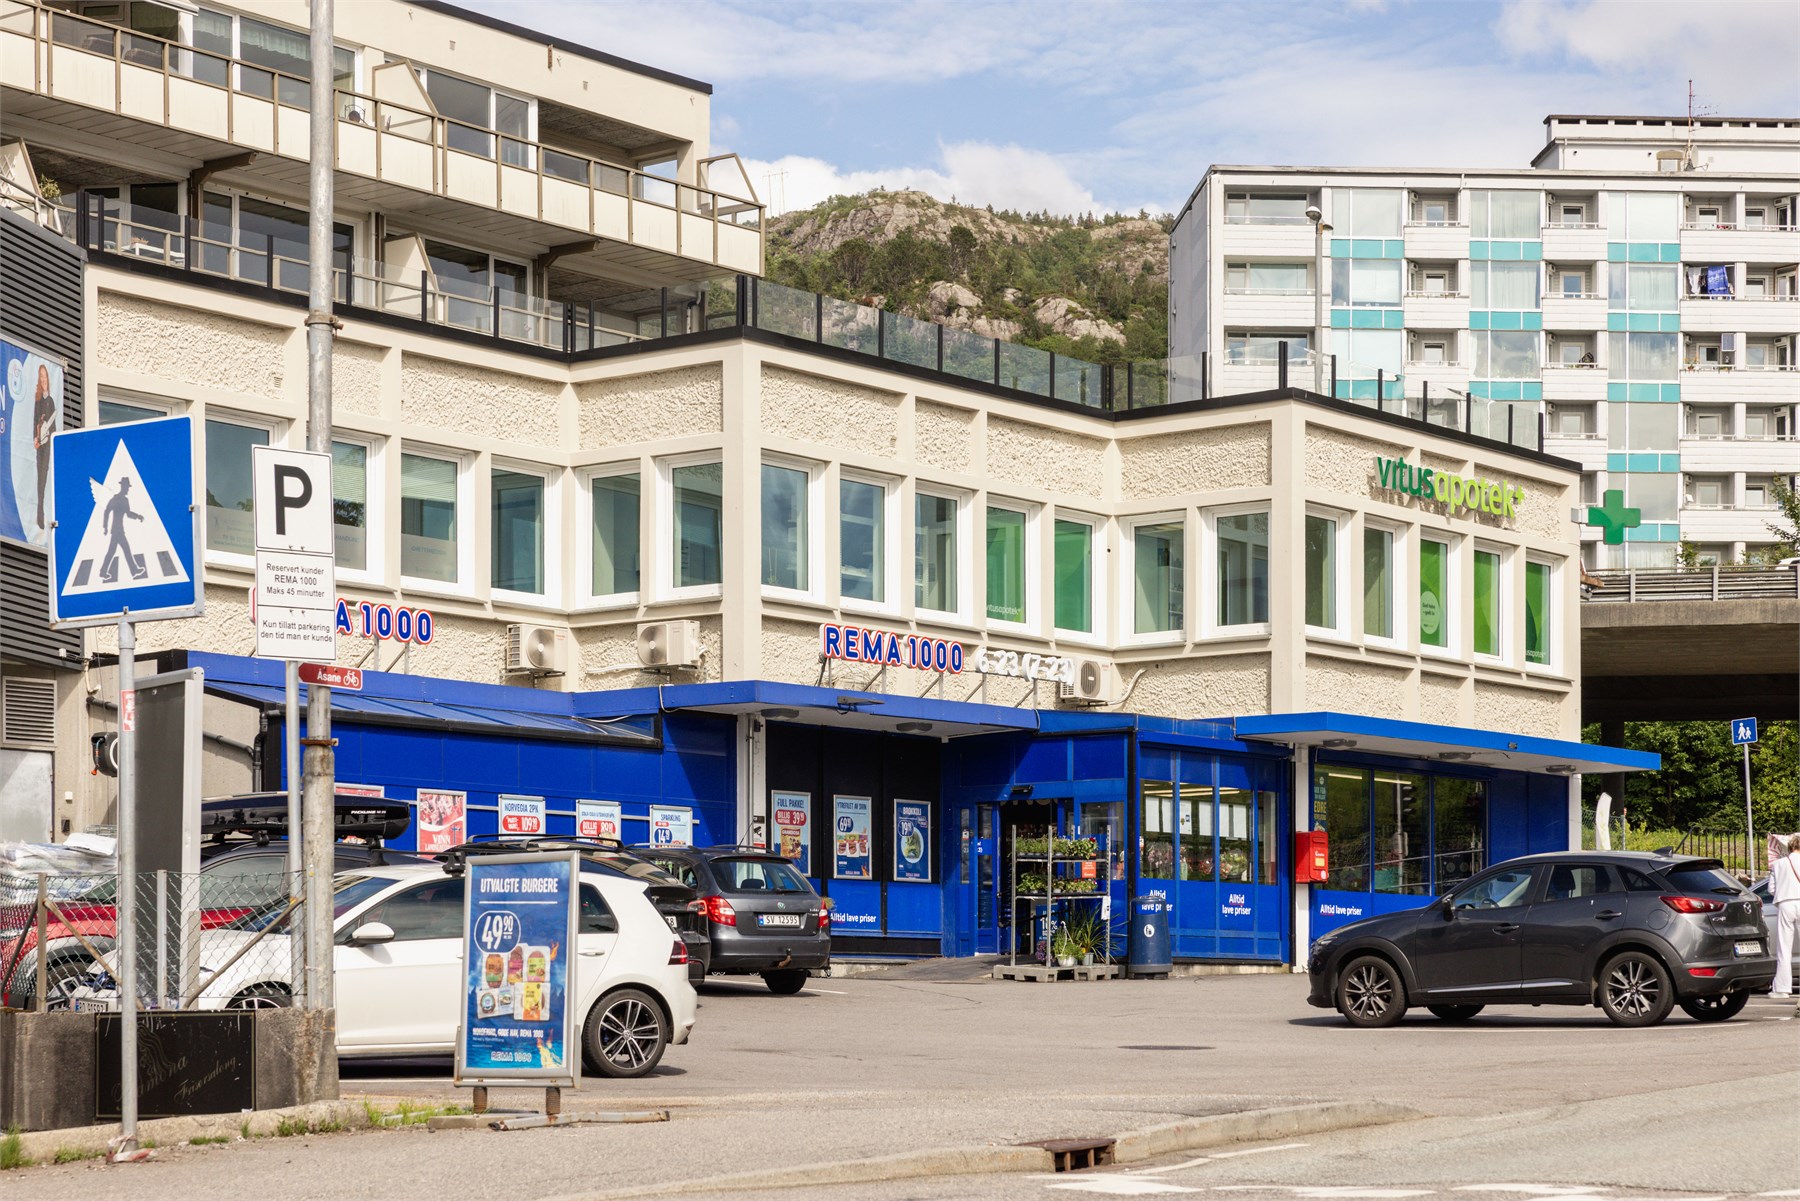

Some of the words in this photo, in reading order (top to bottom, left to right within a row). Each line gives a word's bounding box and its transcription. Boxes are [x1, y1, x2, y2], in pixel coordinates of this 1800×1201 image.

[1376, 456, 1515, 518] vitusapotek
[274, 464, 312, 535] P
[267, 563, 299, 573] Reservert
[301, 566, 324, 575] kunder
[274, 575, 298, 584] REMA
[300, 577, 317, 586] 1000
[267, 587, 285, 595] Maks
[297, 589, 325, 597] minutter
[263, 620, 277, 628] Kun
[279, 621, 297, 630] tillatt
[298, 623, 330, 633] parkering
[357, 601, 434, 645] 1000
[261, 630, 274, 638] den
[276, 631, 284, 639] tid
[312, 633, 332, 642] kunde
[820, 624, 903, 667] REMA
[906, 634, 964, 674] 1000
[976, 647, 1018, 676] 6-23
[1022, 653, 1075, 686] (7-23)
[317, 668, 341, 682] Åsane
[504, 803, 528, 812] NORVEGIA
[777, 798, 788, 808] FULL
[792, 811, 800, 824] 39
[481, 878, 519, 893] UTVALGTE
[521, 878, 558, 893] BURGERE
[1229, 894, 1245, 903] Alltid
[1155, 904, 1173, 912] prer
[1222, 905, 1234, 914] lave
[1234, 905, 1251, 916] priser
[1320, 904, 1334, 914] Alltid
[1335, 905, 1346, 915] lave
[1346, 906, 1362, 916] priser
[765, 915, 775, 924] SV
[778, 915, 798, 924] 12595
[829, 913, 846, 922] Alltid
[846, 913, 858, 922] lave
[859, 914, 876, 925] priser
[482, 915, 503, 949] 49
[503, 916, 513, 932] 90
[491, 1051, 513, 1061] REMA
